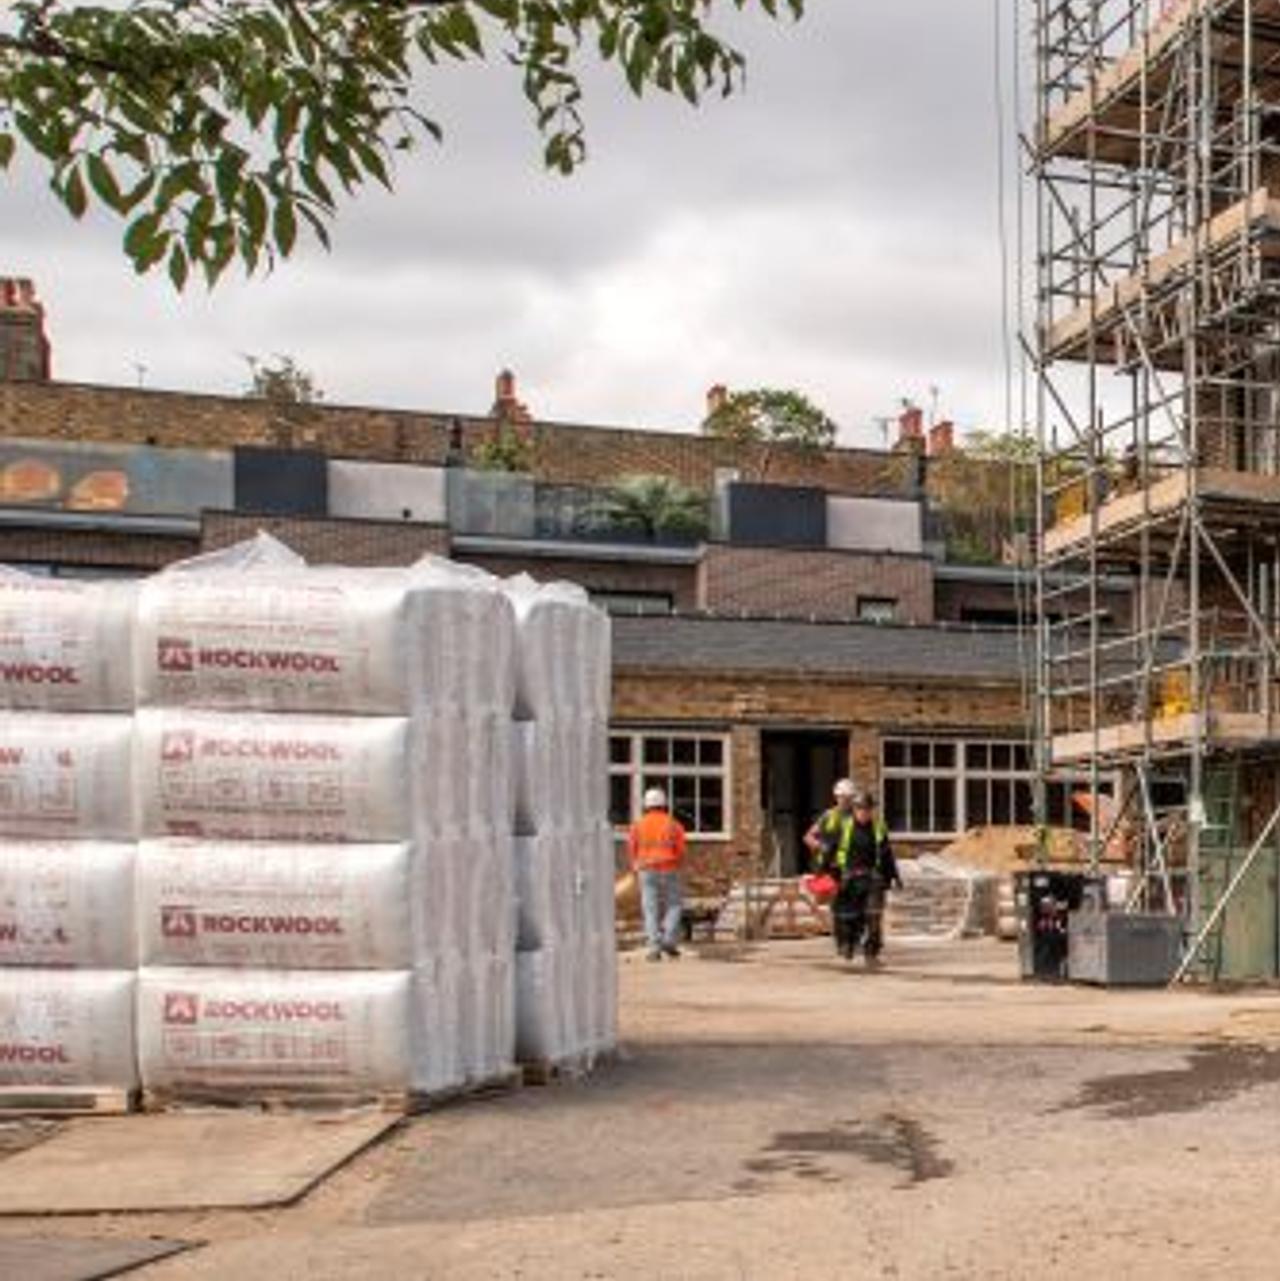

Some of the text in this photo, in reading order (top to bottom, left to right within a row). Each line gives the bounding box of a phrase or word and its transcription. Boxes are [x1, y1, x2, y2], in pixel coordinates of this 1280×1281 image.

[199, 647, 340, 672] ROCKWOOL
[201, 737, 341, 760] ROCKWOOL
[202, 912, 344, 934] ROCKWOOL
[203, 999, 344, 1021] ROCKWOOL
